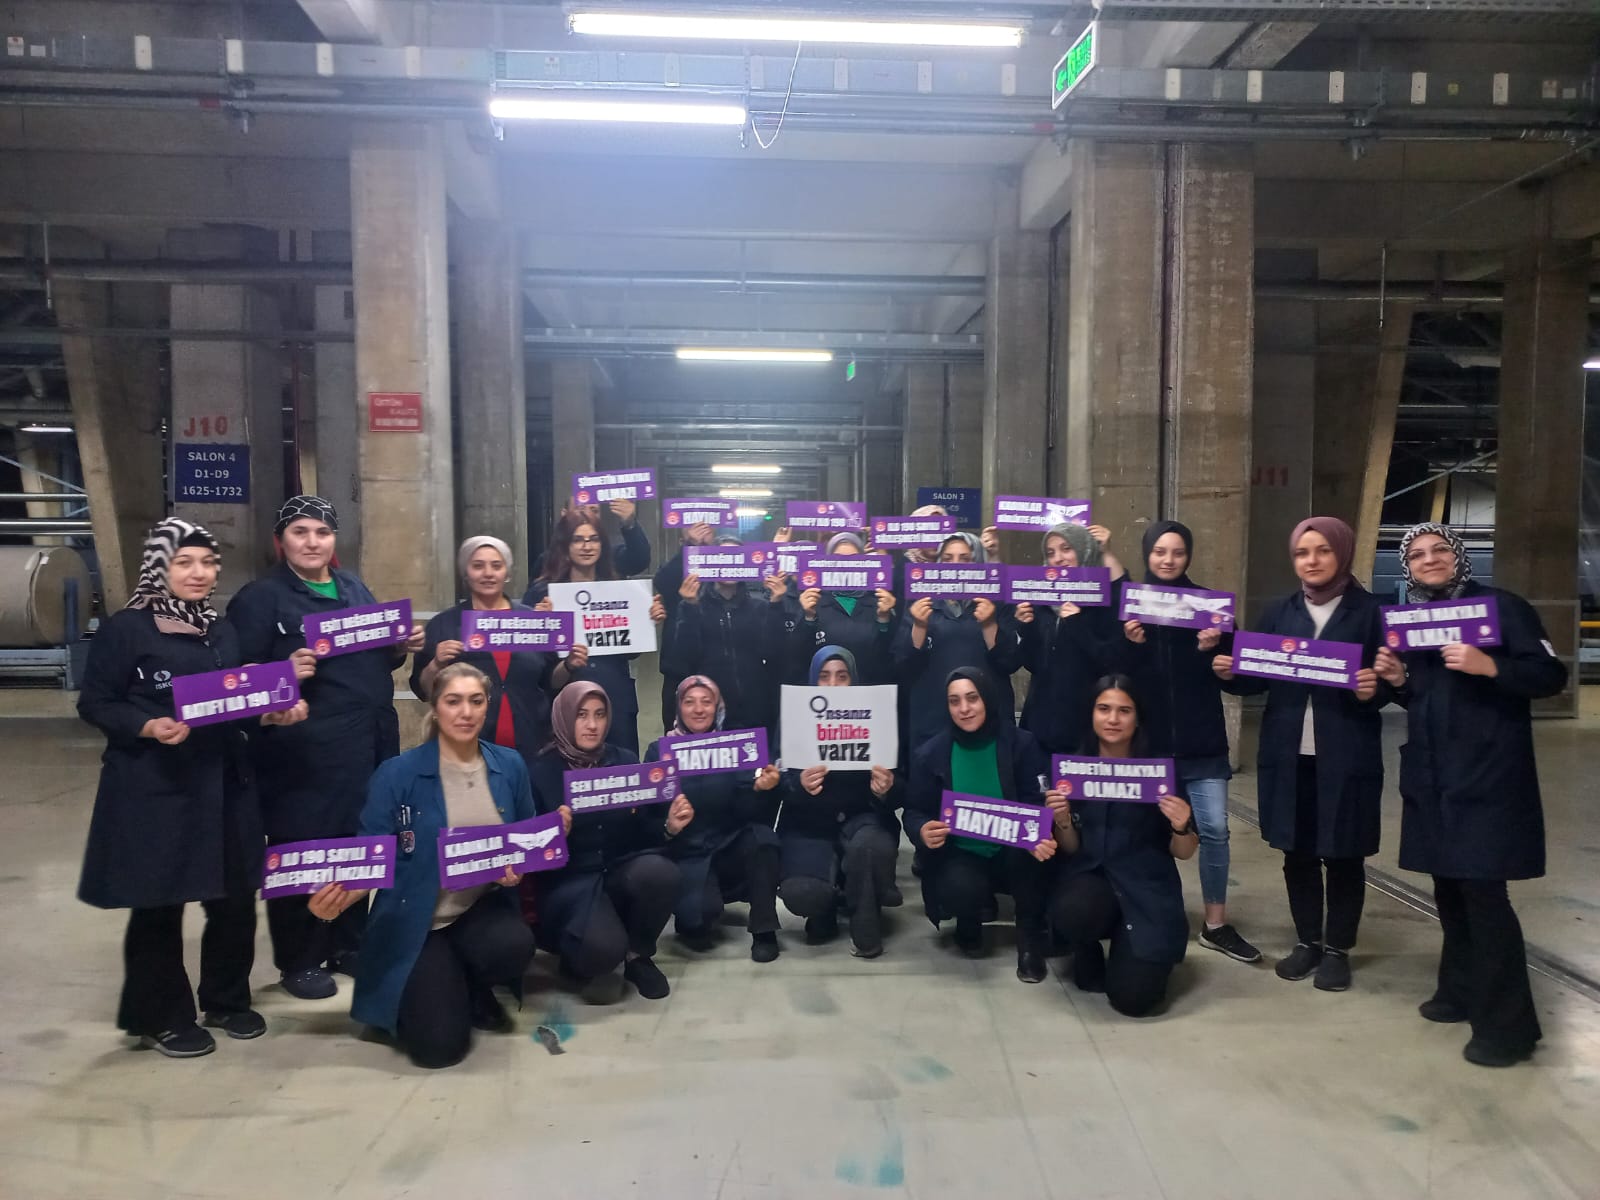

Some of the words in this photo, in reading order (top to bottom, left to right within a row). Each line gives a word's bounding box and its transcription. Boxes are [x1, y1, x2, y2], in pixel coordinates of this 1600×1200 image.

[184, 416, 228, 437] J10
[188, 452, 226, 461] SALON
[229, 452, 236, 462] 4
[194, 469, 230, 478] D1-D9
[183, 486, 242, 496] 1625-1732
[932, 492, 958, 500] SALON
[822, 572, 868, 586] HAYIR!
[583, 614, 628, 630] birlikte
[586, 630, 630, 646] varız
[1406, 626, 1462, 647] OLMAZ!
[246, 690, 270, 708] 190
[817, 724, 870, 741] birlikte
[676, 747, 738, 770] HAYIR!
[818, 743, 870, 761] varız
[1059, 760, 1112, 776] ŞİDDETİN
[570, 780, 592, 793] SEN
[1083, 780, 1142, 799] OLMAZ!
[955, 808, 1020, 843] HAYIR!
[280, 852, 300, 867] ILO
[300, 850, 326, 864] 190
